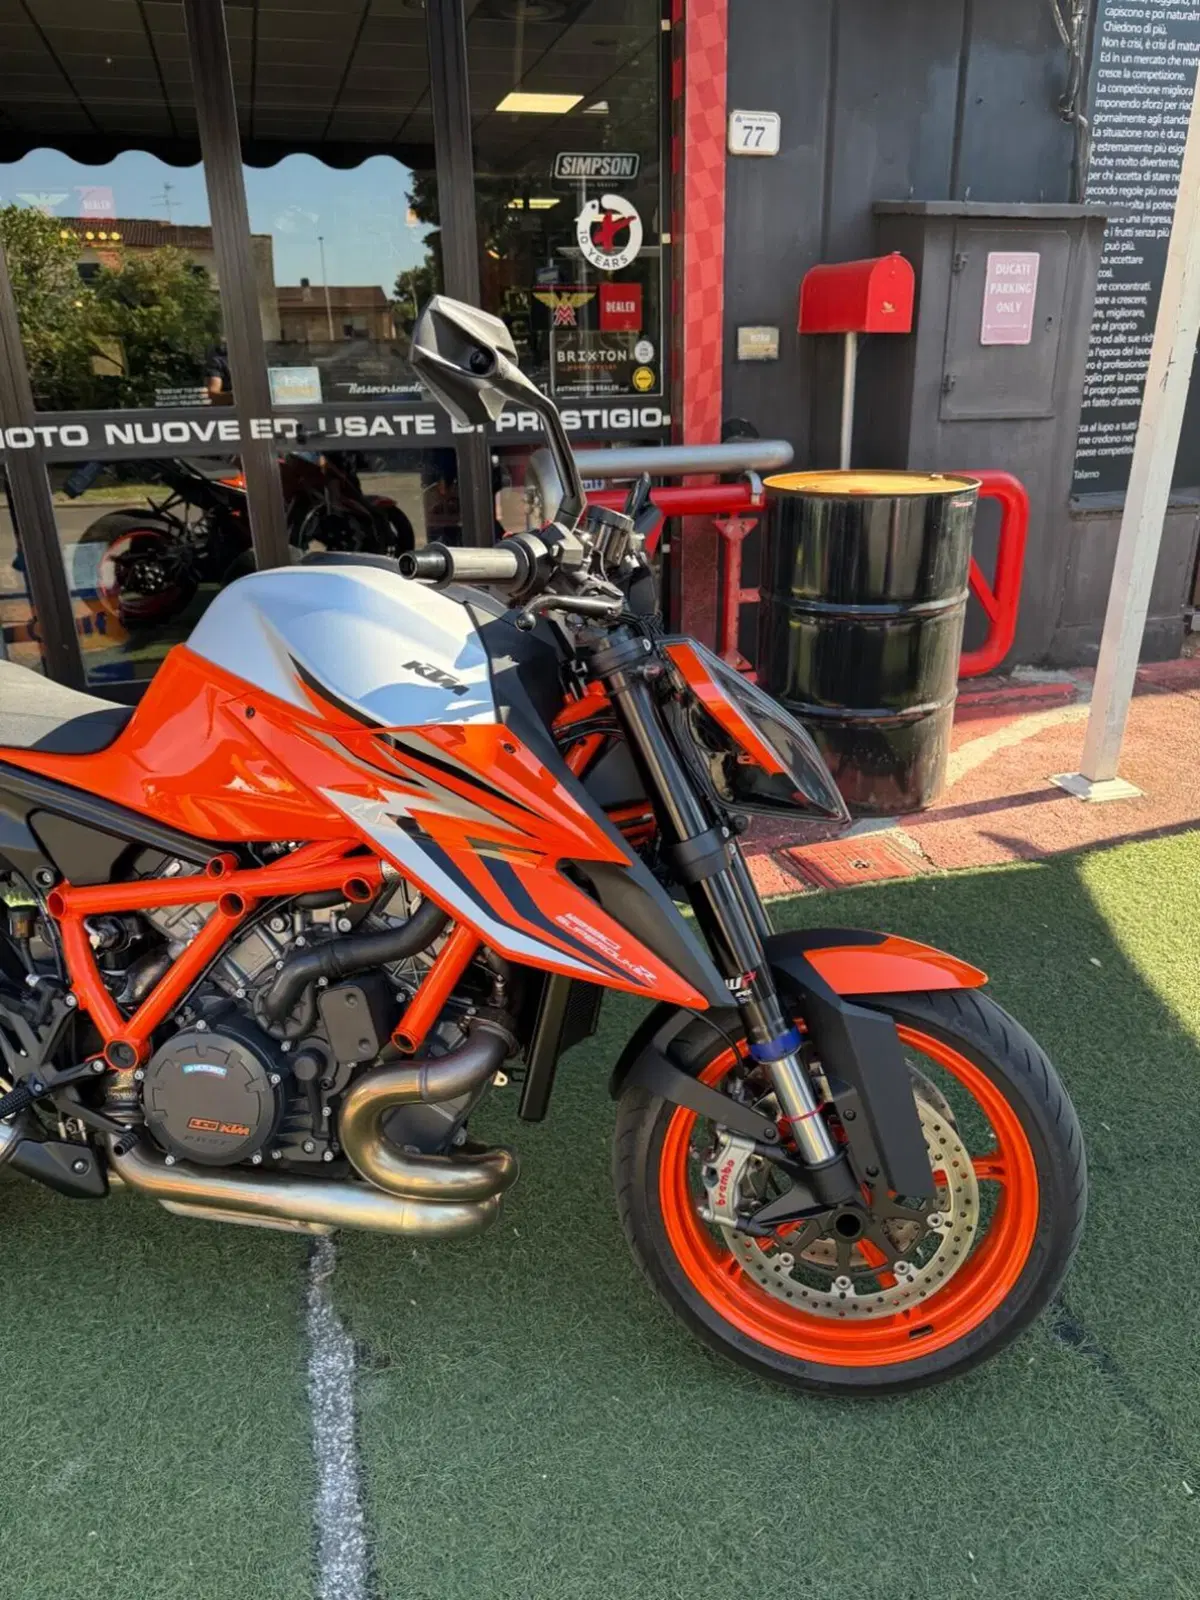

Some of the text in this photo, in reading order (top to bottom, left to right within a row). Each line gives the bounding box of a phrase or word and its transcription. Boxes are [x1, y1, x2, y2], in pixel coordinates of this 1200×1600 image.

[1104, 6, 1144, 18] capiscono
[1152, 8, 1165, 21] poi
[1103, 20, 1142, 33] Chiedono
[1143, 23, 1151, 33] di
[1102, 36, 1118, 47] Non
[1152, 40, 1166, 50] crisi
[1168, 40, 1176, 50] di
[1100, 52, 1110, 62] Ed
[1112, 53, 1120, 63] in
[1121, 55, 1132, 63] un
[1134, 56, 1166, 65] mercato
[1168, 54, 1181, 66] che
[1098, 69, 1122, 78] cresce
[1124, 68, 1130, 78] la
[1096, 82, 1193, 97] La competizione migliora
[1095, 97, 1140, 110] imponendo
[1164, 102, 1177, 111] per
[1093, 112, 1146, 124] giornalmente
[743, 126, 765, 147] 77
[1092, 127, 1101, 136] La
[1103, 127, 1142, 138] situazione
[1144, 130, 1158, 138] non
[1097, 142, 1152, 152] estremamente
[1154, 143, 1166, 154] più
[561, 156, 632, 175] SIMPSON
[1090, 157, 1113, 167] Anche
[1115, 157, 1138, 167] molto
[1088, 172, 1101, 181] per
[1102, 170, 1114, 180] chi
[1115, 171, 1141, 180] accetta
[1143, 170, 1151, 181] di
[1152, 172, 1170, 181] stare
[1086, 186, 1117, 195] secondo
[1120, 186, 1143, 197] regole
[1144, 186, 1157, 197] più
[1114, 226, 1134, 236] frutti
[1135, 229, 1155, 237] senza
[588, 248, 628, 268] YEARS
[1109, 256, 1144, 264] accettare
[996, 263, 1032, 276] DUCATI
[990, 283, 1032, 294] PARKING
[605, 301, 636, 313] DEALER
[996, 301, 1022, 313] ONLY
[1101, 322, 1109, 330] al
[1110, 321, 1137, 332] proprio
[1102, 334, 1112, 343] ed
[1114, 334, 1127, 343] alle
[557, 350, 627, 362] BRIXTON
[1122, 346, 1132, 356] del
[1103, 374, 1116, 383] per
[1117, 373, 1124, 381] la
[1089, 386, 1116, 397] proprio
[1092, 398, 1110, 407] fatto
[0, 425, 88, 449] OTO
[104, 420, 241, 445] NUOVE
[250, 418, 299, 439] ED
[318, 414, 436, 438] USATE
[496, 408, 662, 432] PRSTIGIO
[1098, 423, 1114, 433] lupo
[1074, 470, 1100, 479] Talamo
[401, 660, 470, 696] KTM
[715, 1159, 735, 1206] brembo
